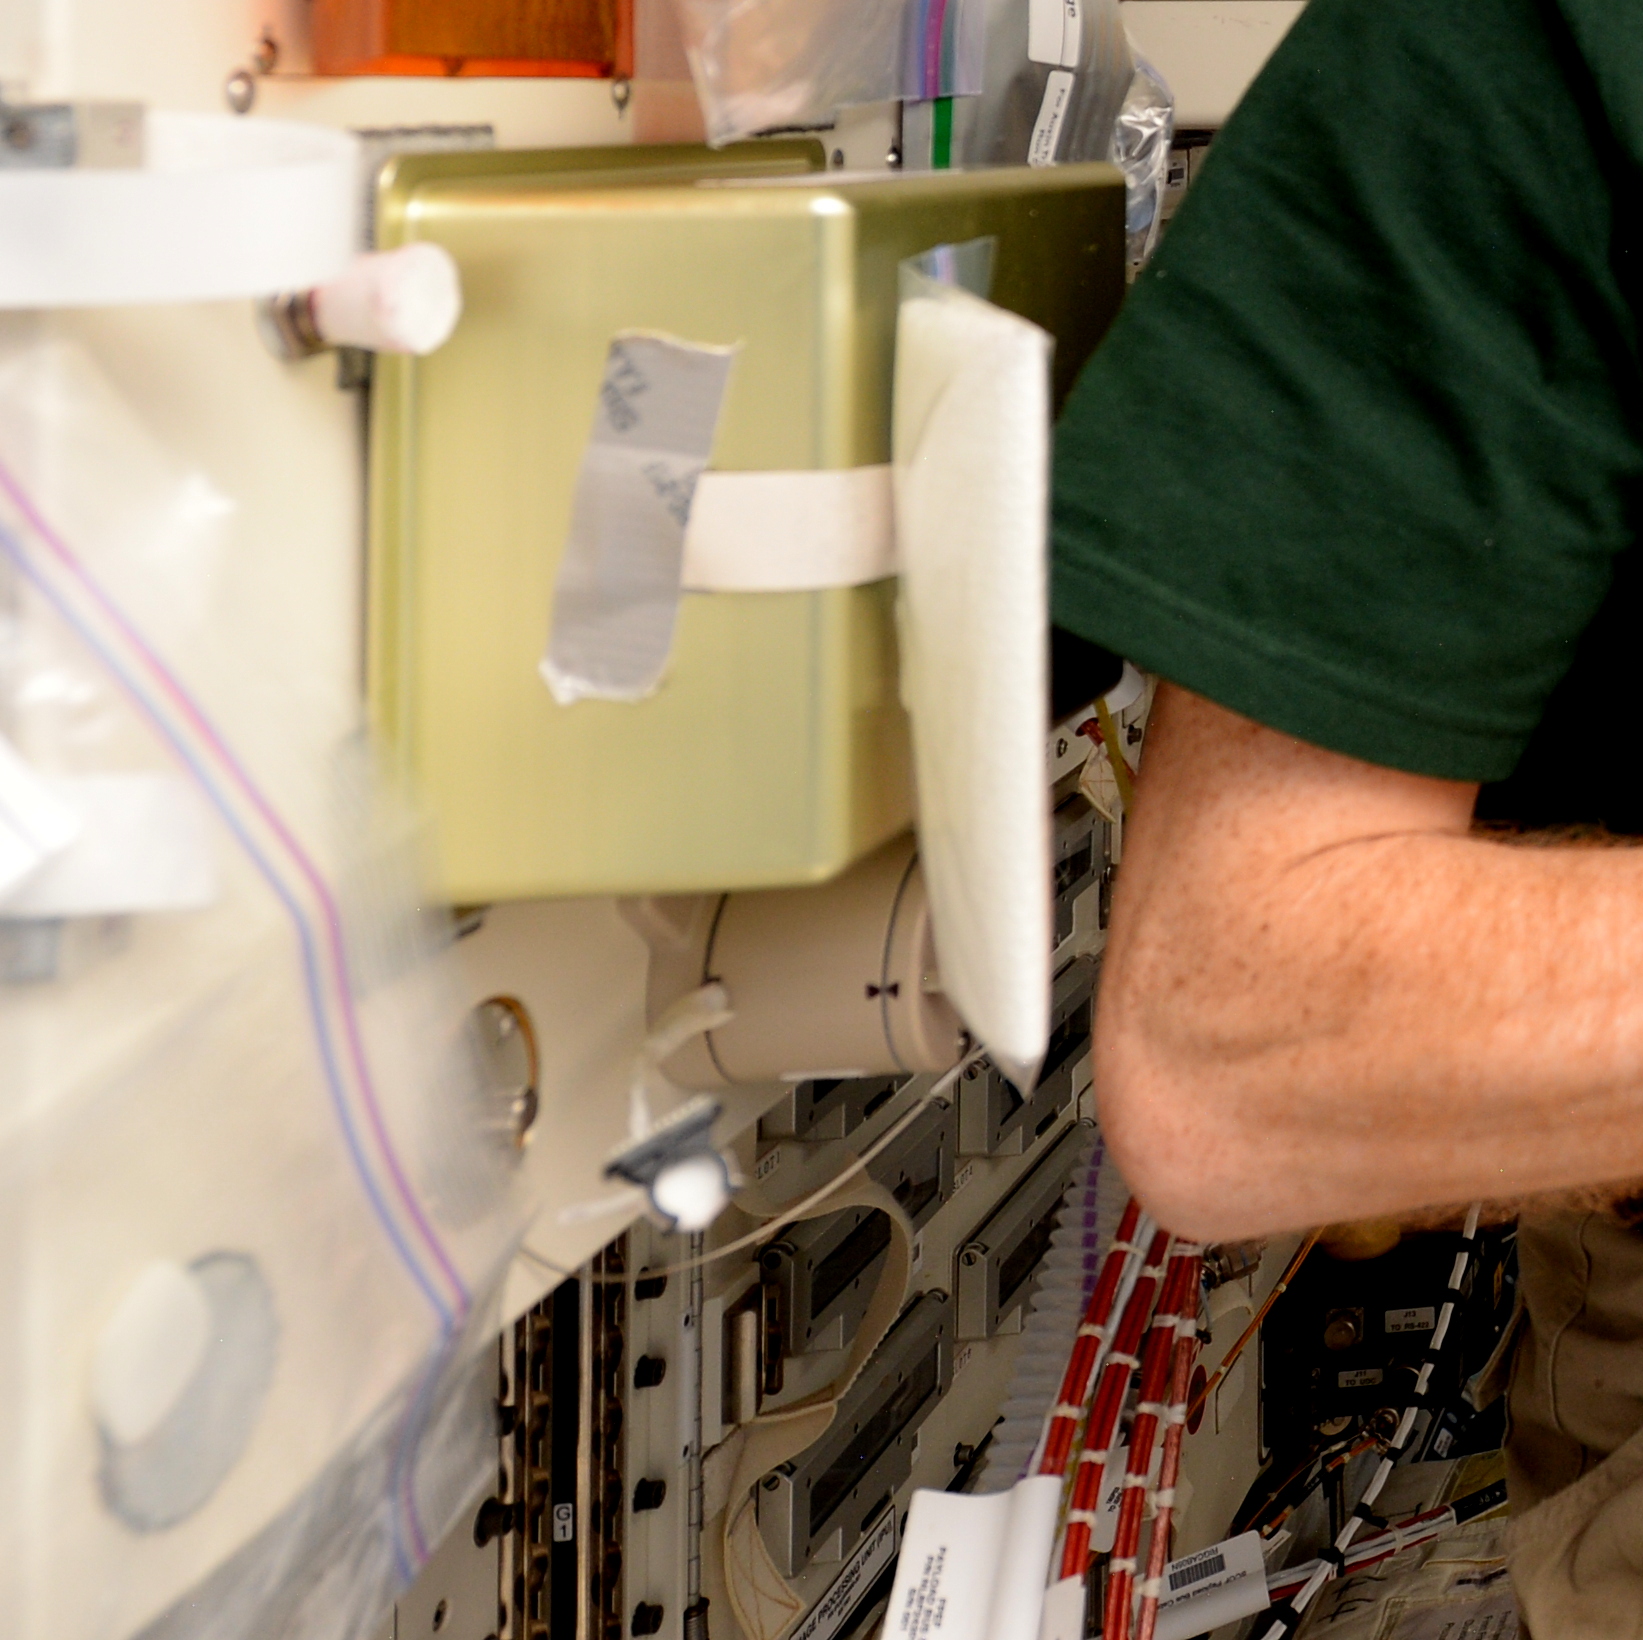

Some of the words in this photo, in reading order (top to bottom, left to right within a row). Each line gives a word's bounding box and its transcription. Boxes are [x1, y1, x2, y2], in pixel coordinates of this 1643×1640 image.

[1390, 1323, 1402, 1332] TO
[1344, 1378, 1357, 1387] TO
[816, 1558, 864, 1618] PROCESSING
[926, 1546, 946, 1605] PAYLOAD
[921, 1607, 933, 1632] BUS
